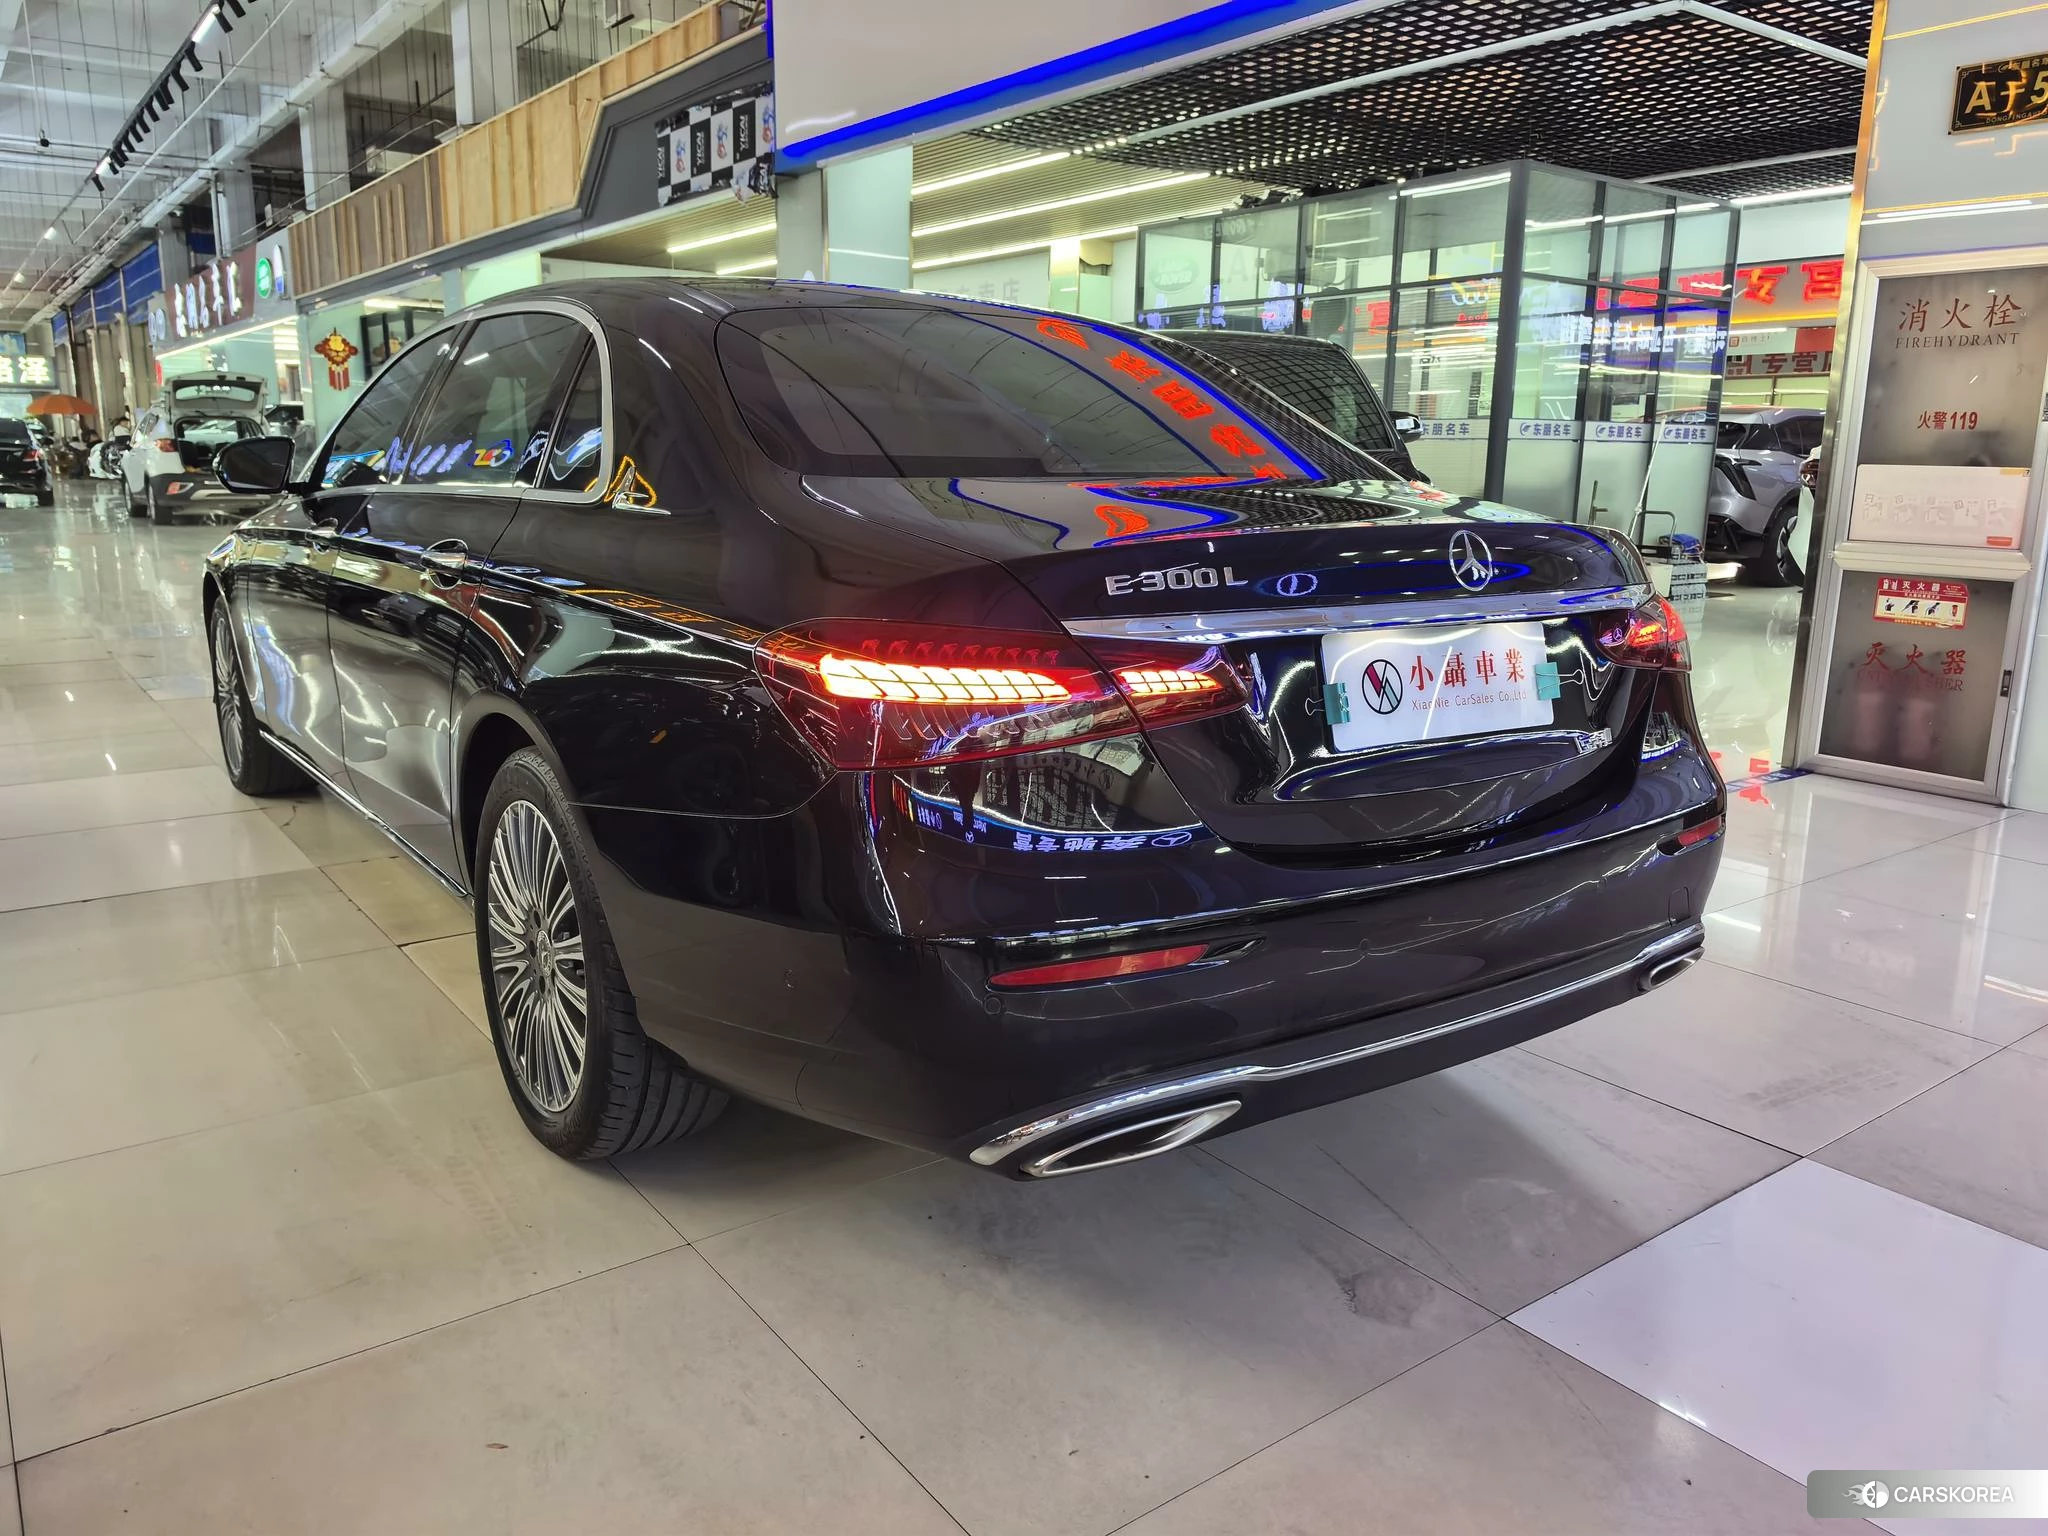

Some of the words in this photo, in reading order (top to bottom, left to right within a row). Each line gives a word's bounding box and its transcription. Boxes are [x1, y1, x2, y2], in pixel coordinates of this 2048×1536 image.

[1899, 294, 2022, 332] 消火栓
[1896, 333, 2020, 349] FIREHYDRANT
[1532, 422, 1571, 436] 东朋名车
[1607, 424, 1642, 438] 东朋名车
[1674, 427, 1706, 440] 东朋名车
[1862, 641, 1966, 677] 灭火器
[1409, 648, 1526, 691] 小聶車業
[1411, 698, 1450, 712] XiaoNie
[1455, 694, 1494, 708] CarSales
